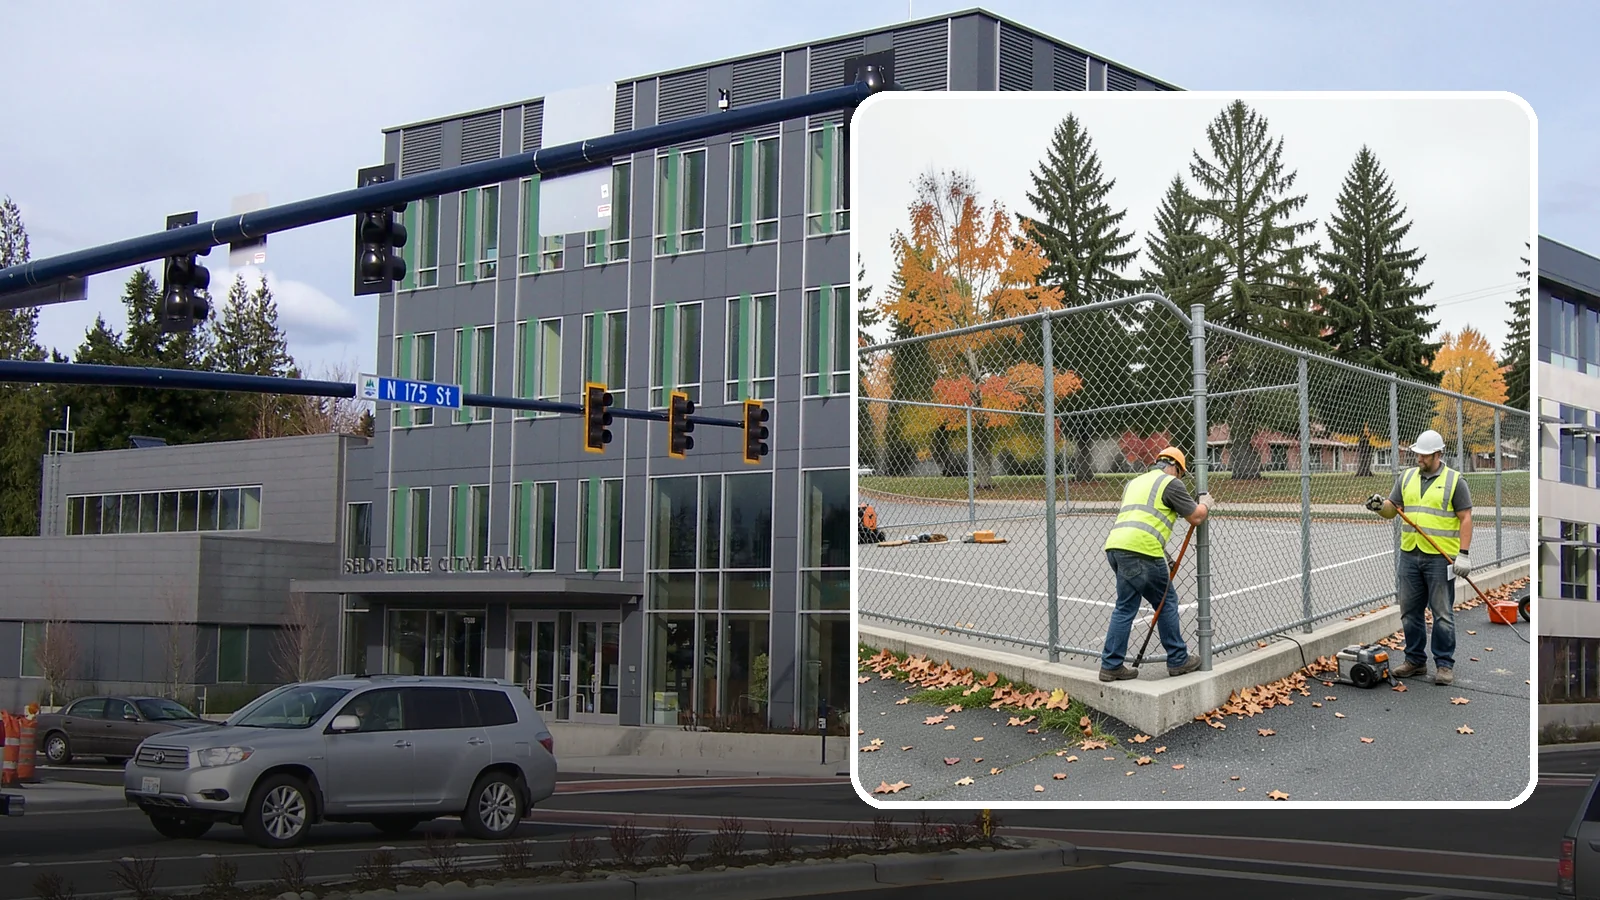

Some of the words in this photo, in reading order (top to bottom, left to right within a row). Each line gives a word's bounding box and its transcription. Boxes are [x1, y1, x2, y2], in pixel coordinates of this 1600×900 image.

[387, 381, 396, 399] N
[405, 383, 427, 403] 175
[436, 386, 451, 406] St
[344, 557, 432, 573] SHORELINE
[438, 556, 476, 572] CITY
[484, 555, 526, 571] HALL
